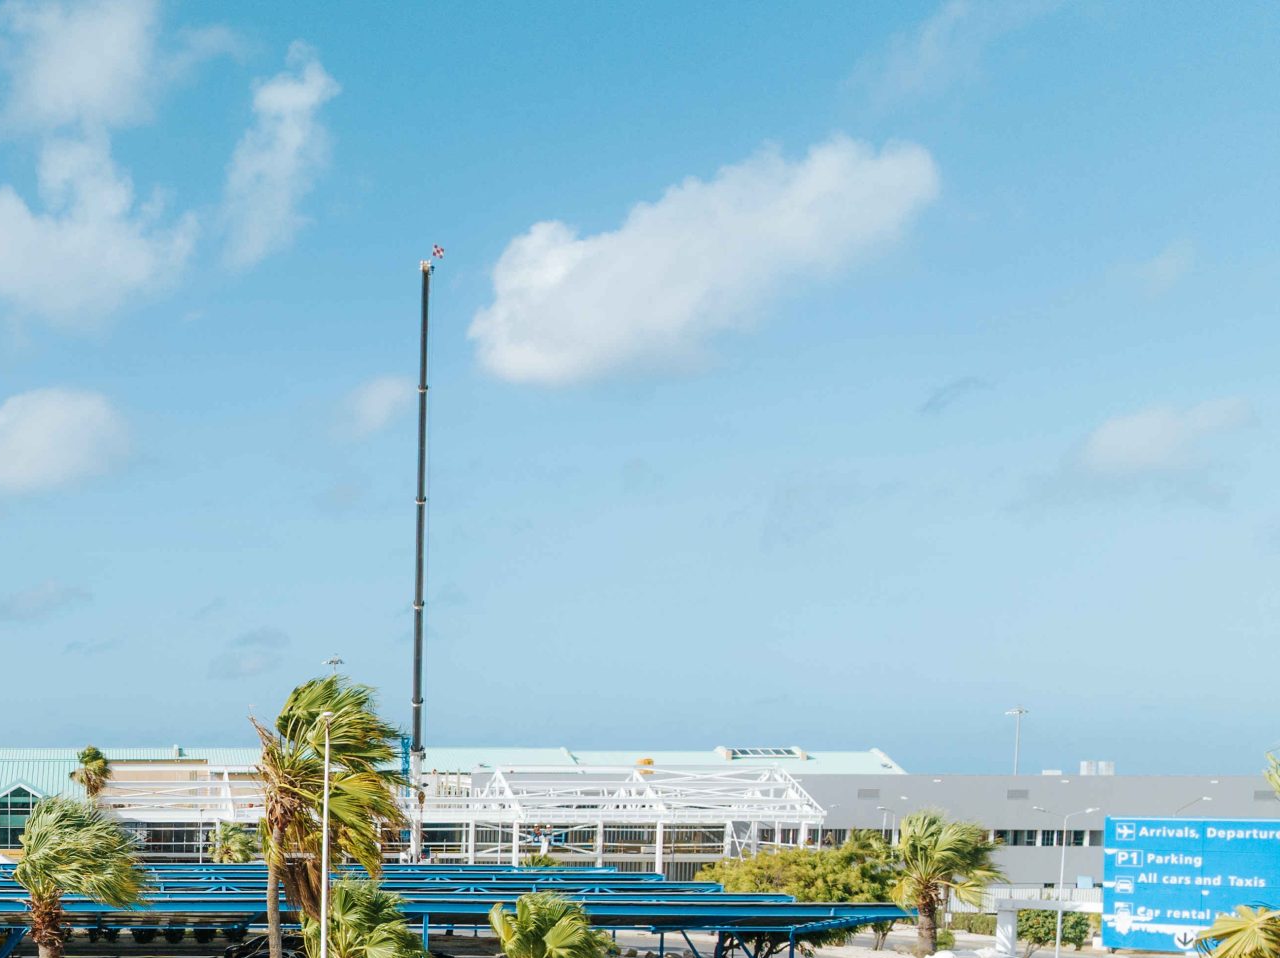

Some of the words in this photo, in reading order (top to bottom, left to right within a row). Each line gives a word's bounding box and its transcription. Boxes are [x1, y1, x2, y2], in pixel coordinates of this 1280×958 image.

[1138, 826, 1200, 839] Arrivals,
[1117, 852, 1138, 865] P1
[1146, 853, 1203, 867] Parking
[1137, 873, 1158, 884] All
[1162, 875, 1191, 885] cars
[1194, 875, 1222, 886] and
[1228, 875, 1266, 888] Taxis
[1136, 906, 1161, 918] Car
[1166, 908, 1211, 920] rental
